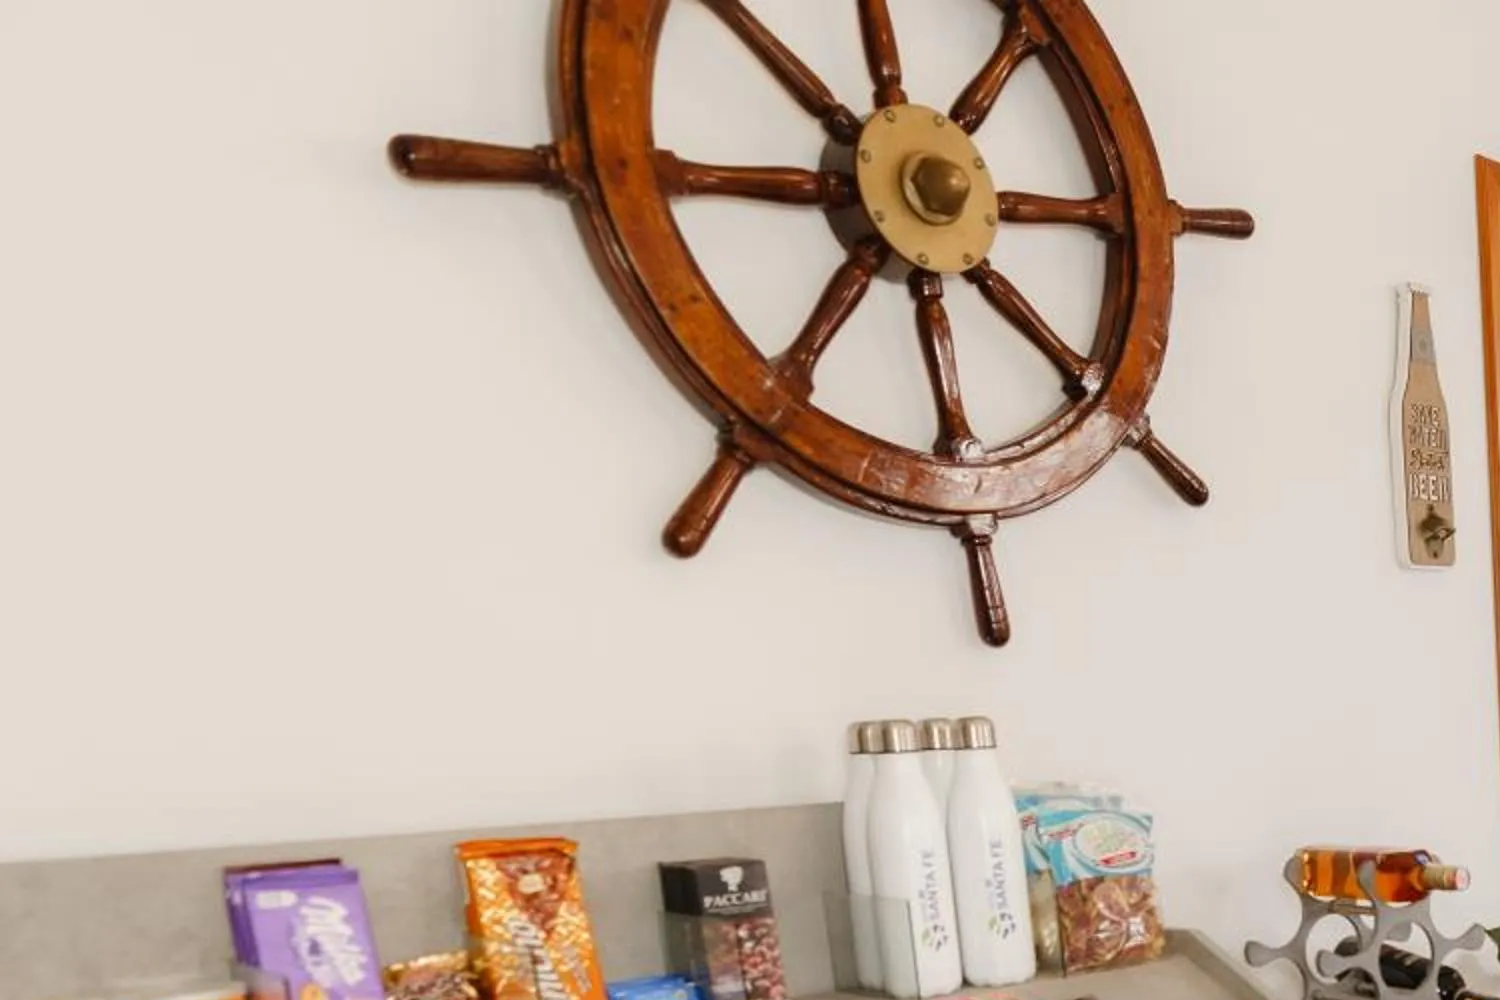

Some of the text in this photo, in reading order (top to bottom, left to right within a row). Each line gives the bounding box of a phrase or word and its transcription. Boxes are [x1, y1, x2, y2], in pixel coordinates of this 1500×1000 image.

[921, 848, 940, 921] SANTA FE
[989, 838, 1008, 910] SANTA FE
